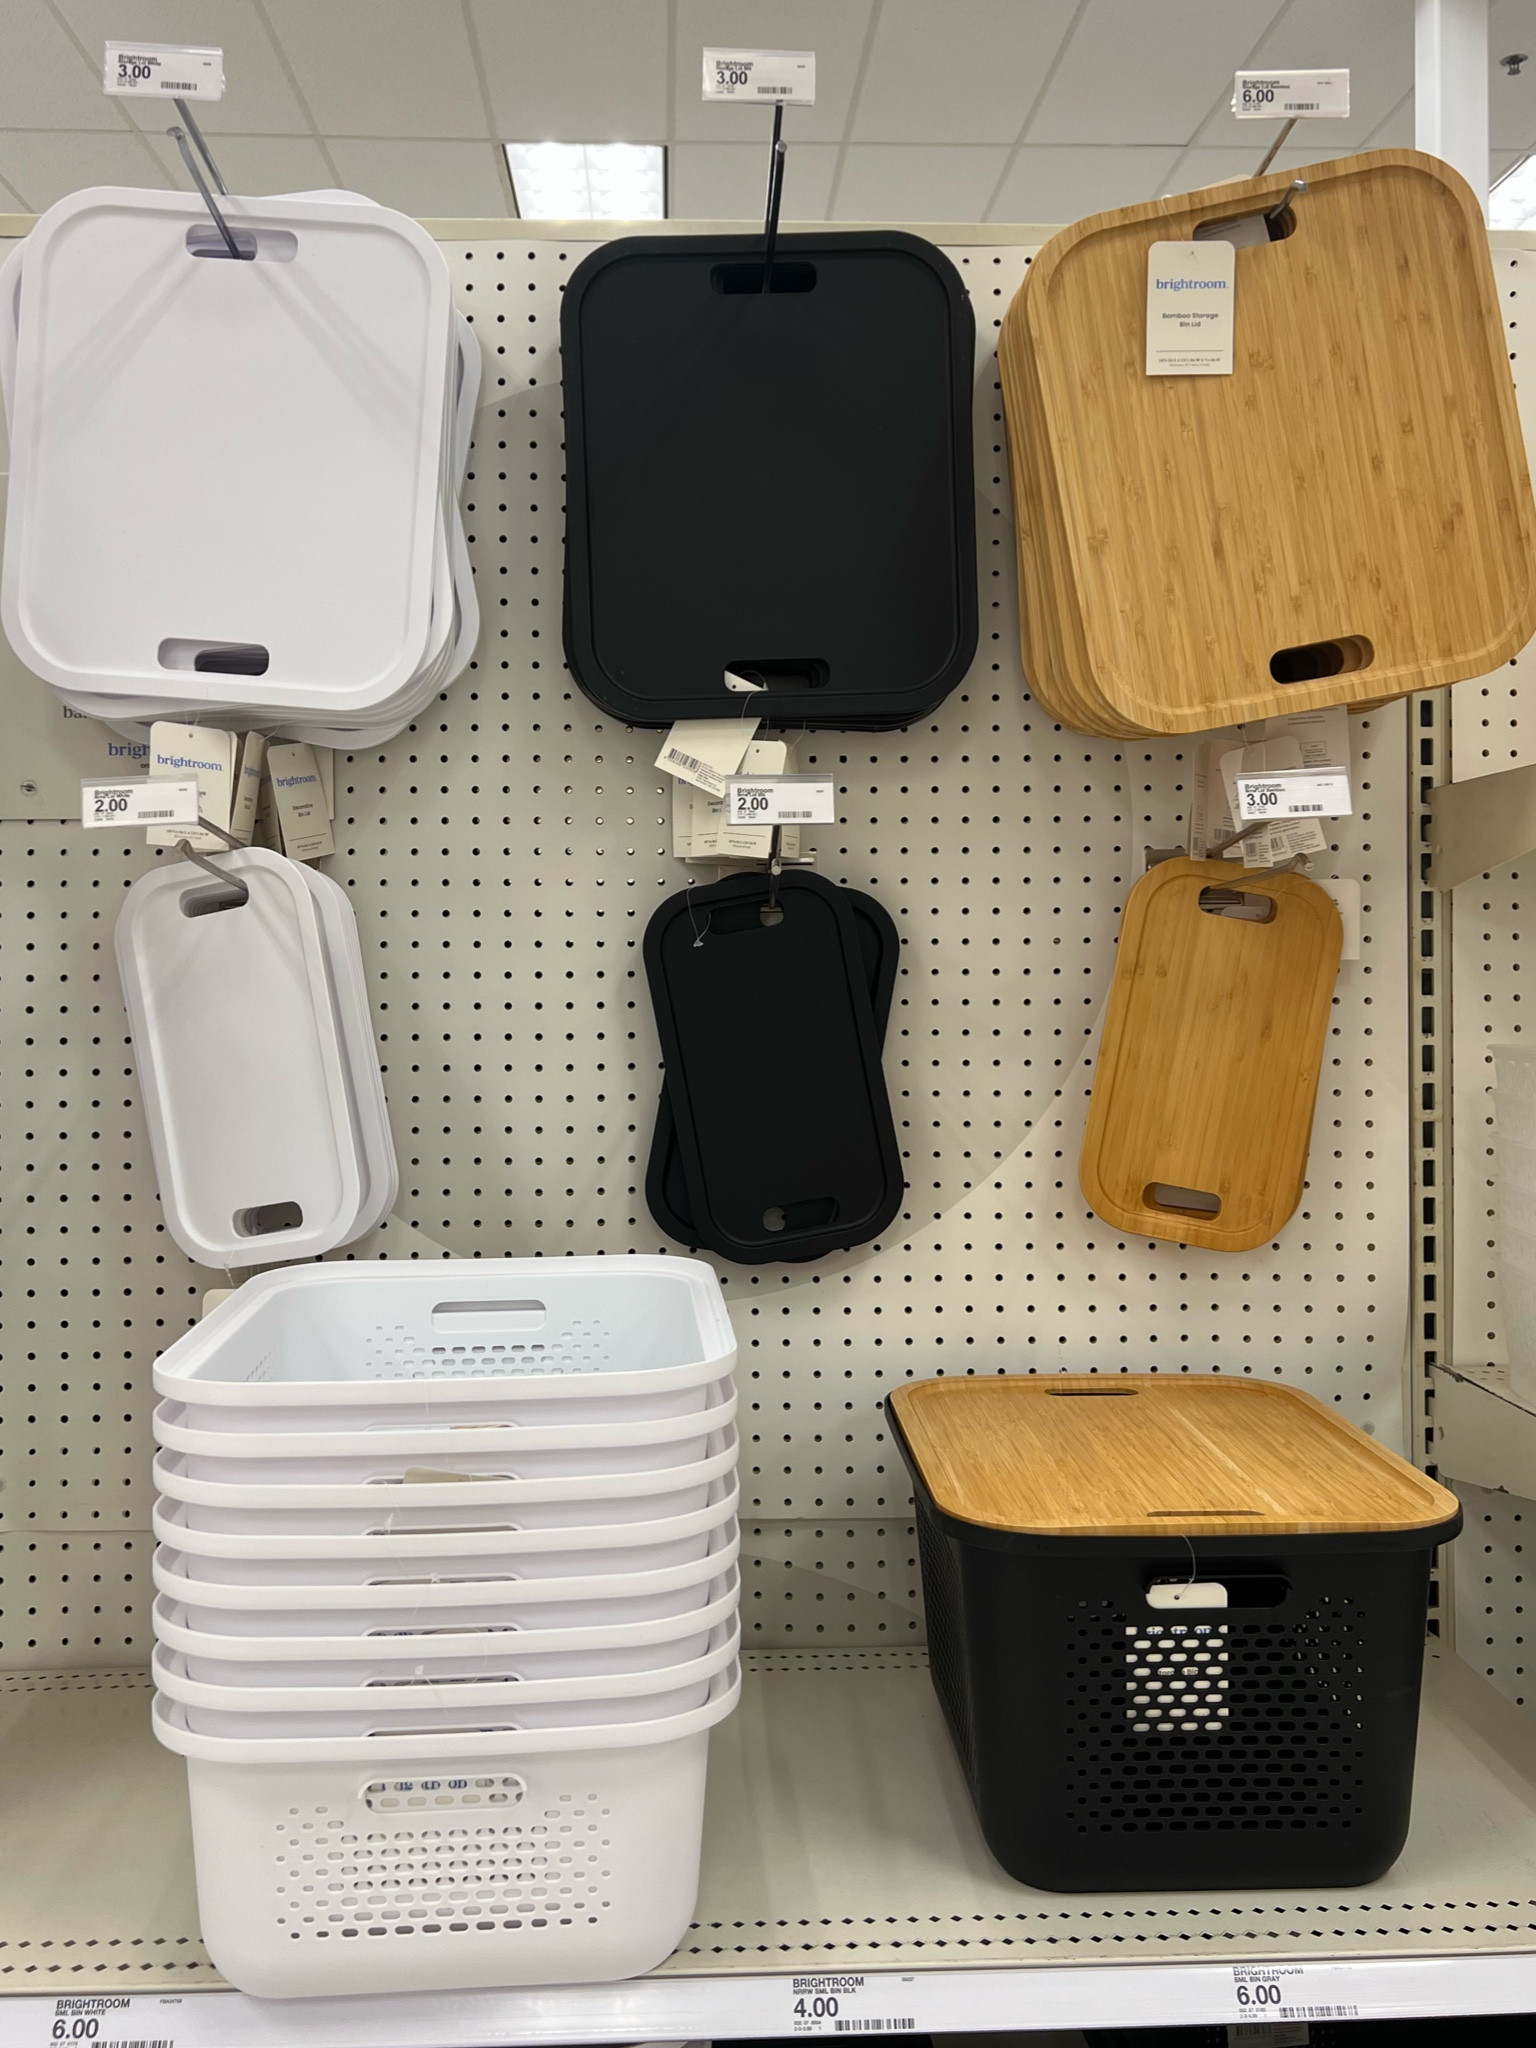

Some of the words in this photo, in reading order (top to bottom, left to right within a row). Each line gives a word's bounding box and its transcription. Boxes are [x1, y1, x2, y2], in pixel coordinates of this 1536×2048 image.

[118, 53, 158, 63] Brightroom
[118, 64, 151, 79] 3.00
[717, 71, 748, 85] 3.00
[1243, 90, 1274, 103] 6.00
[1156, 279, 1226, 291] brightroom
[157, 754, 222, 771] brightroom
[276, 775, 317, 787] brightroom
[95, 798, 128, 812] 2.00
[738, 797, 768, 810] 2.00
[1246, 792, 1278, 806] 3.00
[792, 1976, 864, 1988] BRIGHTROOM
[1236, 1984, 1281, 2006] 6.00
[56, 1998, 130, 2009] BRIGHTROOM
[793, 1996, 839, 2018] 4.00
[52, 2018, 99, 2039] 6.00
